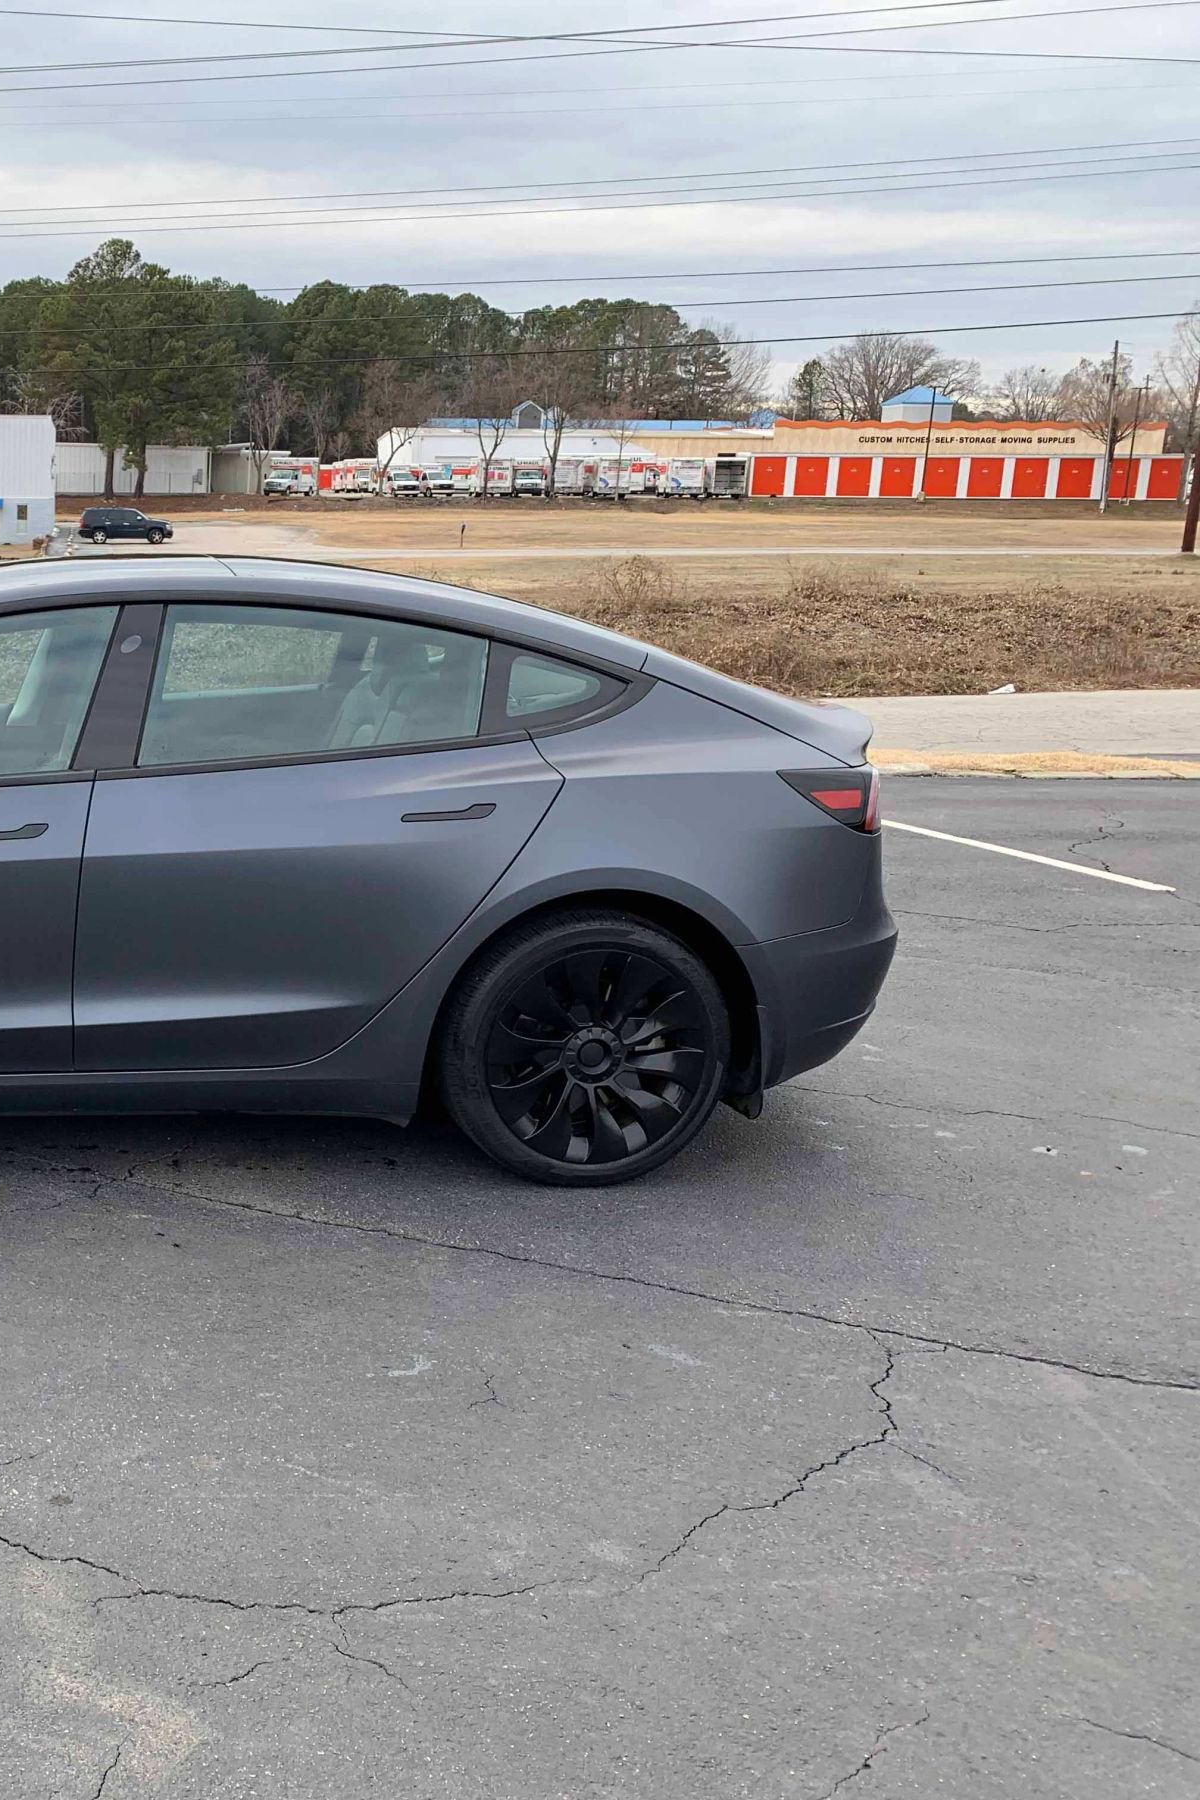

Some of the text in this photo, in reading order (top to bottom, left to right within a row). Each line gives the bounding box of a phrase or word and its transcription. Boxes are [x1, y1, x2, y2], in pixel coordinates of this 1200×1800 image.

[858, 436, 893, 444] CUSTOM
[896, 436, 931, 444] HITCHES
[1000, 436, 1033, 444] MOVING
[1036, 436, 1076, 444] SUPPLIES
